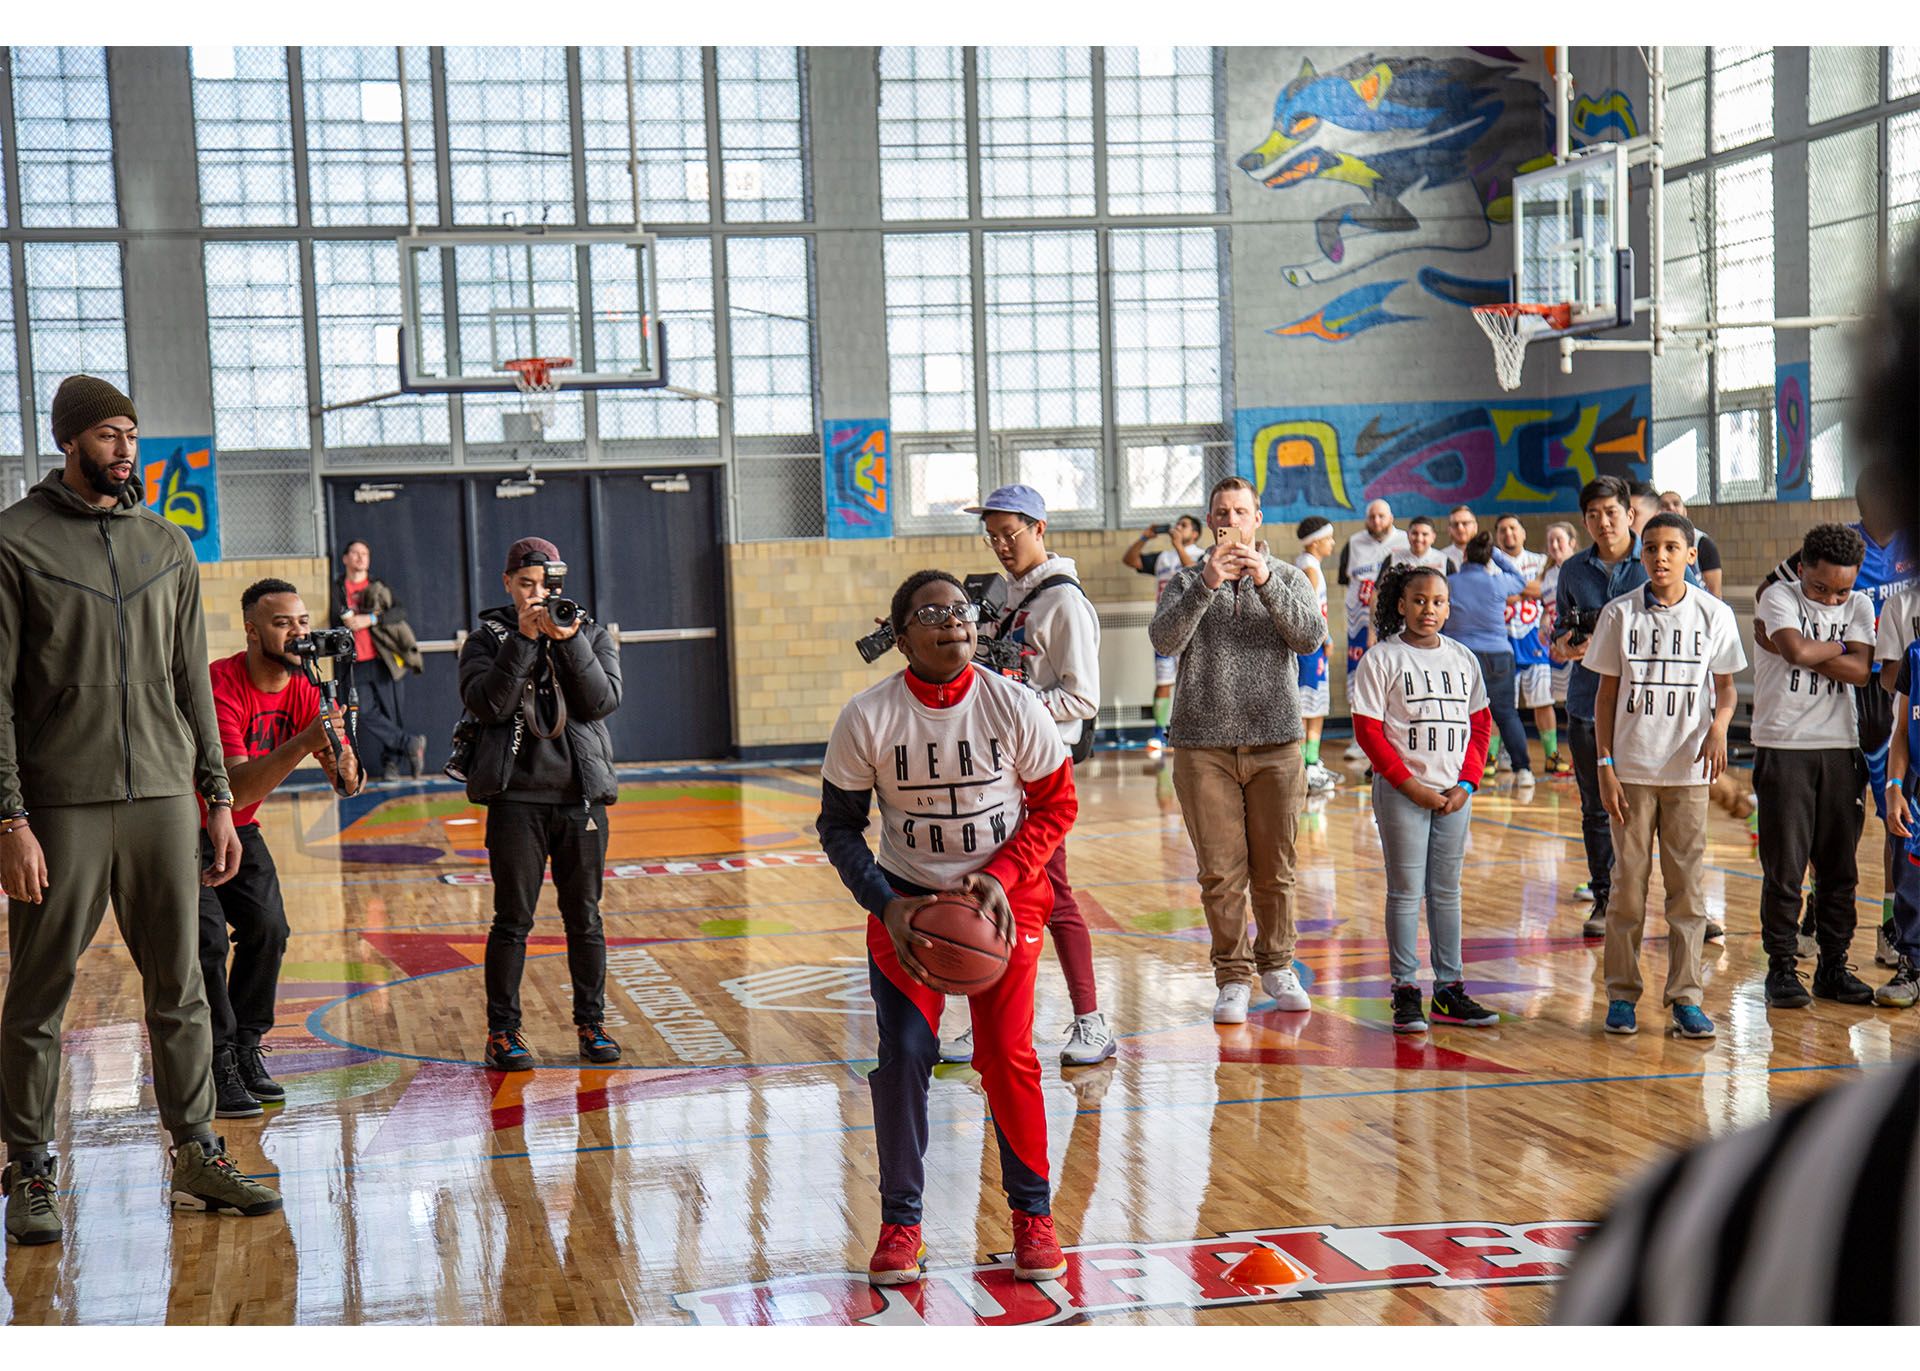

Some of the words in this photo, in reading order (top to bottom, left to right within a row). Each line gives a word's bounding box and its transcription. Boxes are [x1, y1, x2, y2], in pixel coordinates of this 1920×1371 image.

[1629, 629, 1701, 656] HERE
[1404, 670, 1468, 696] HERE
[895, 738, 1003, 780] HERE
[917, 796, 934, 806] AD
[605, 949, 666, 976] BOYS
[615, 975, 673, 987] &
[625, 985, 705, 1019] GIRLS
[653, 1019, 746, 1062] CLUBS
